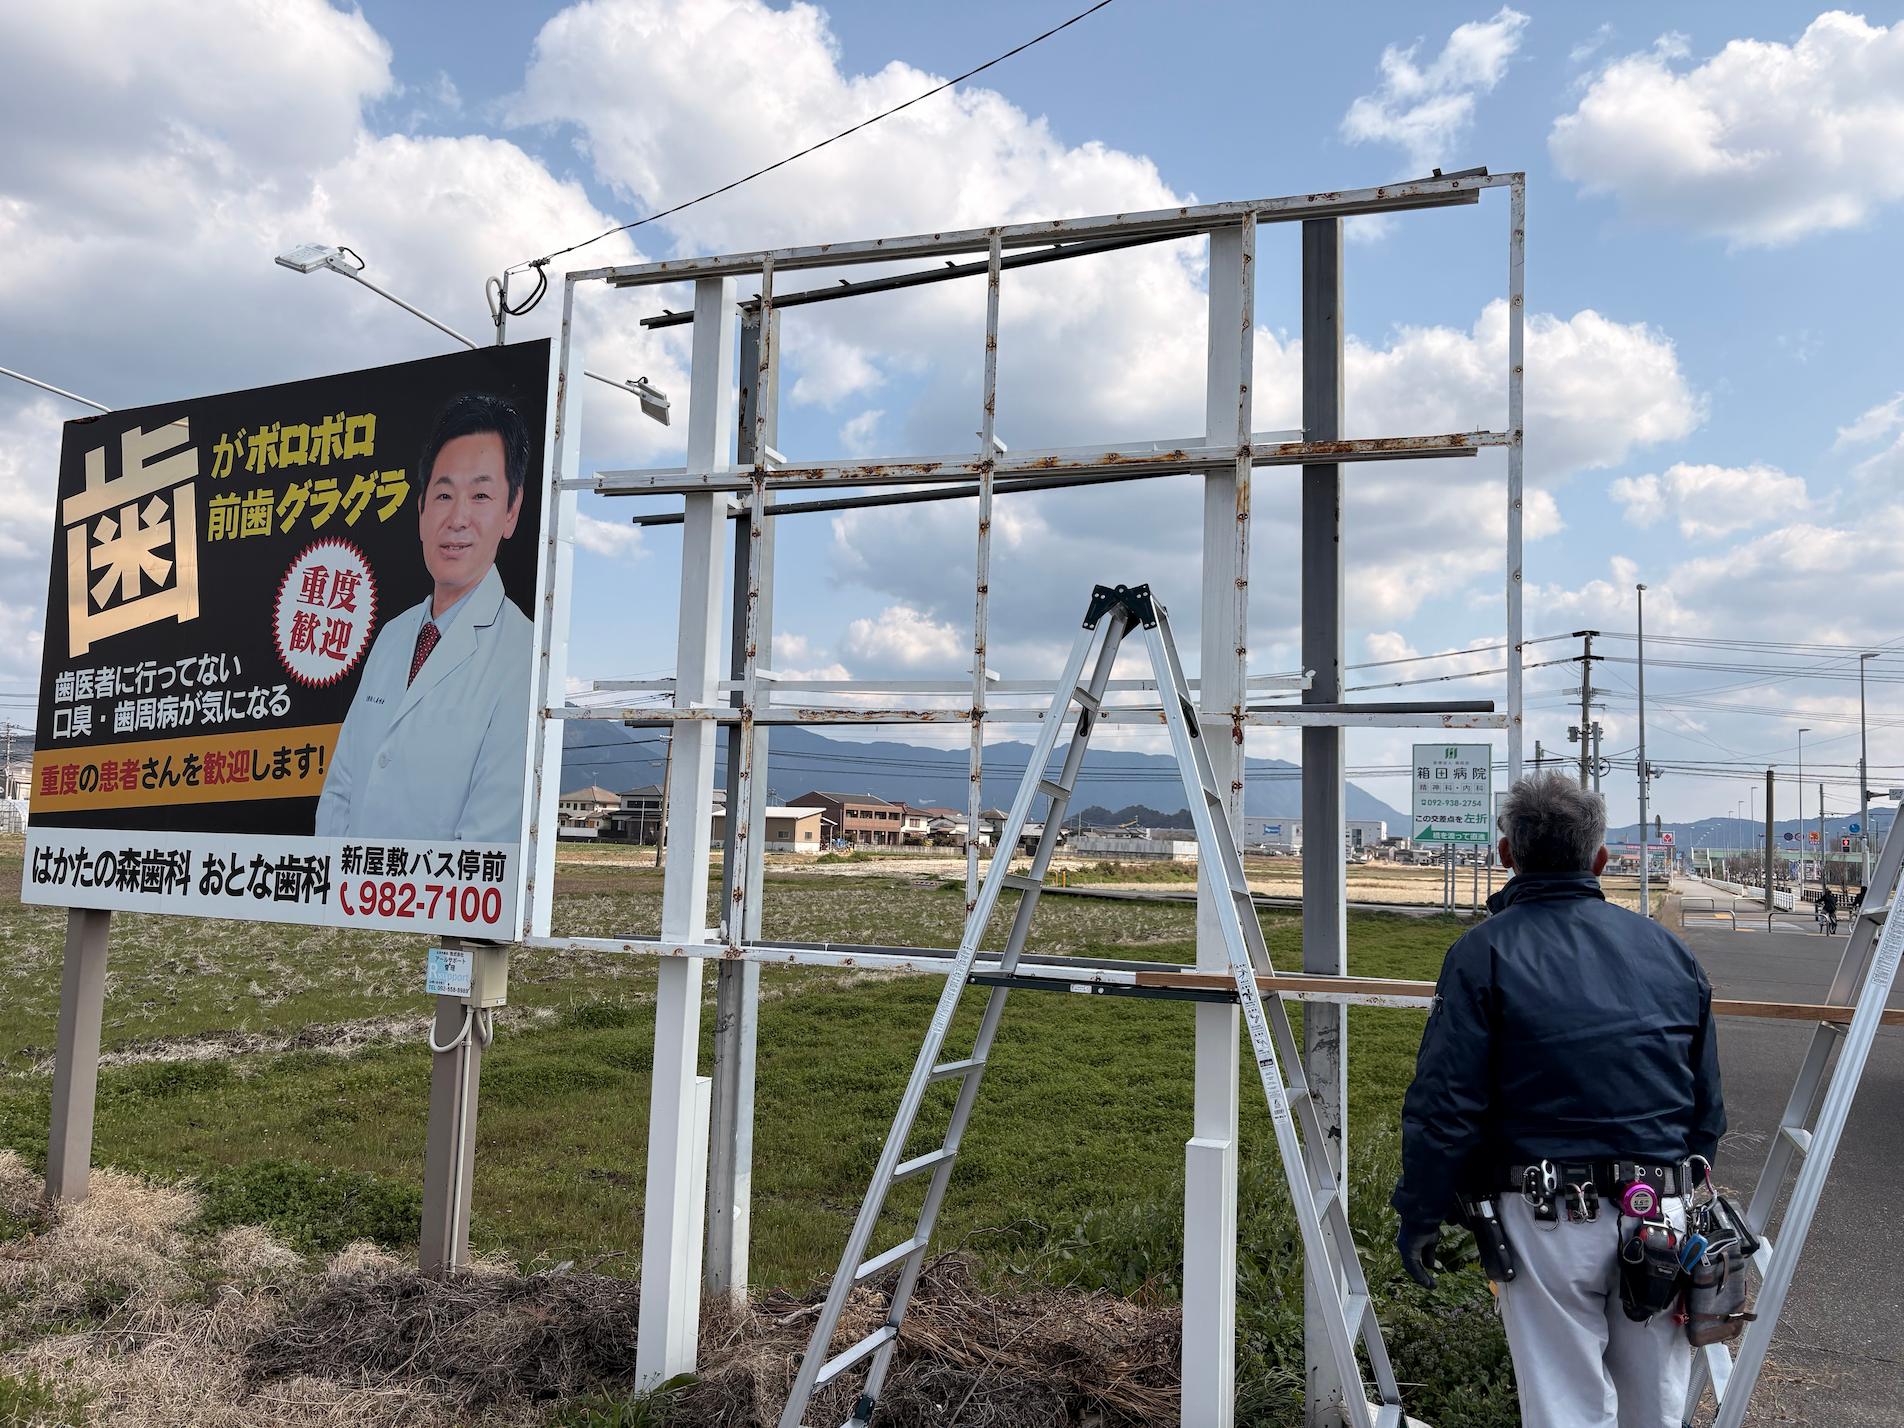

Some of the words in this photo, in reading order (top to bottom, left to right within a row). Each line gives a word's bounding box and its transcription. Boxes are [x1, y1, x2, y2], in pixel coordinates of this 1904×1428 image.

[211, 411, 376, 479] がボロボロ
[208, 469, 411, 542] 前歯グラグラ
[63, 416, 199, 658] 歯
[296, 565, 363, 613] 重度
[289, 610, 353, 662] 歓迎
[54, 653, 242, 704] 歯医者に行ってない
[52, 683, 291, 739] 口臭・歯周病が気になる
[39, 743, 325, 797] 重度の患者さんを歓迎します!
[1417, 767, 1487, 780] 箱田病院
[31, 845, 192, 897] はかたの森歯科
[199, 852, 332, 905] おとな歯科
[341, 844, 507, 882] 新屋敷バス停前
[359, 881, 502, 924] 982-7100
